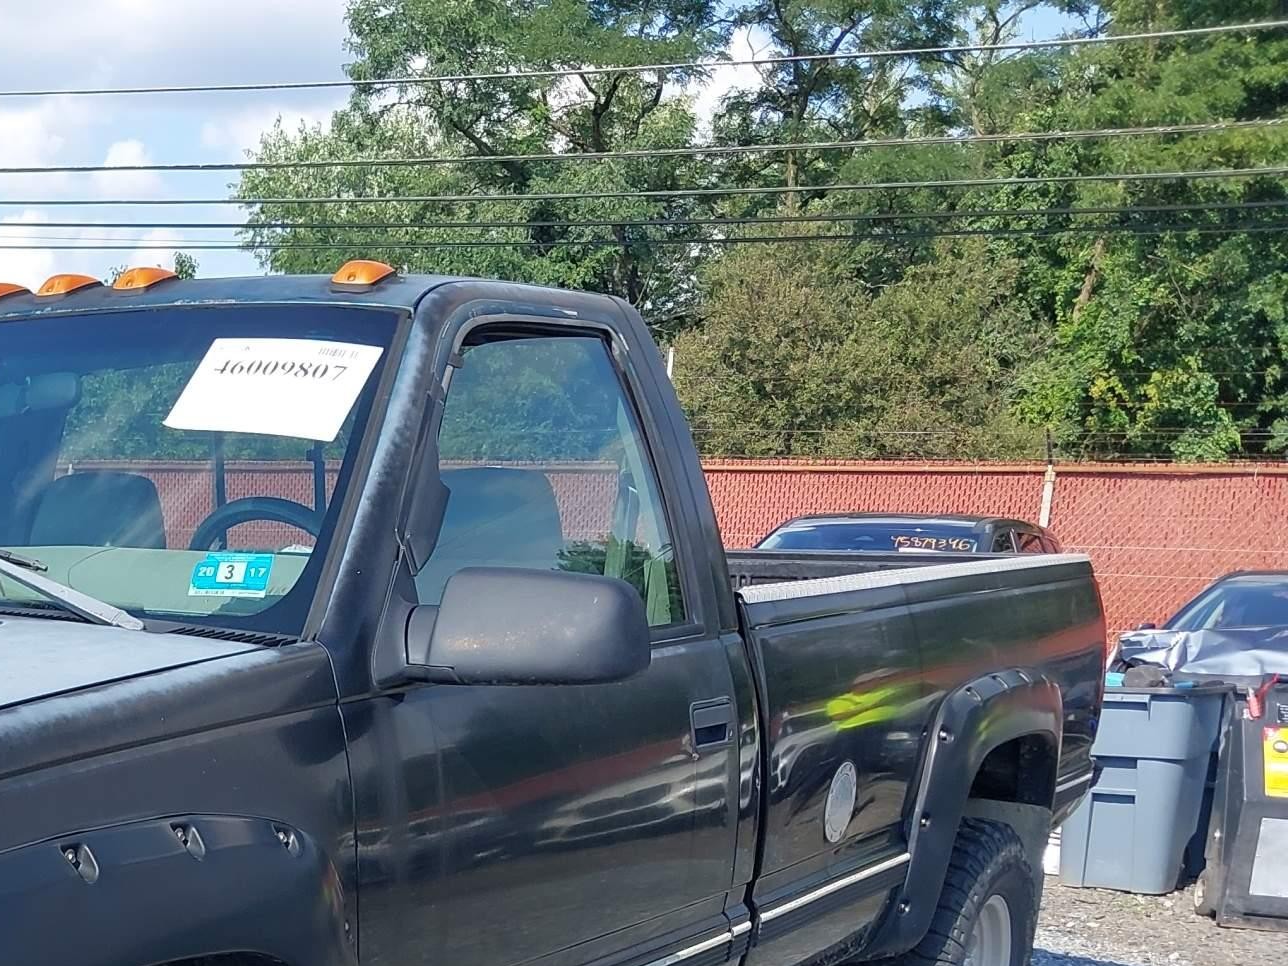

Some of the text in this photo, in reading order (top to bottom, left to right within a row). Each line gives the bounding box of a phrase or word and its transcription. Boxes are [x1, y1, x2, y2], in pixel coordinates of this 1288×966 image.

[214, 358, 349, 381] 46009807
[197, 564, 267, 580] 20 3 17
